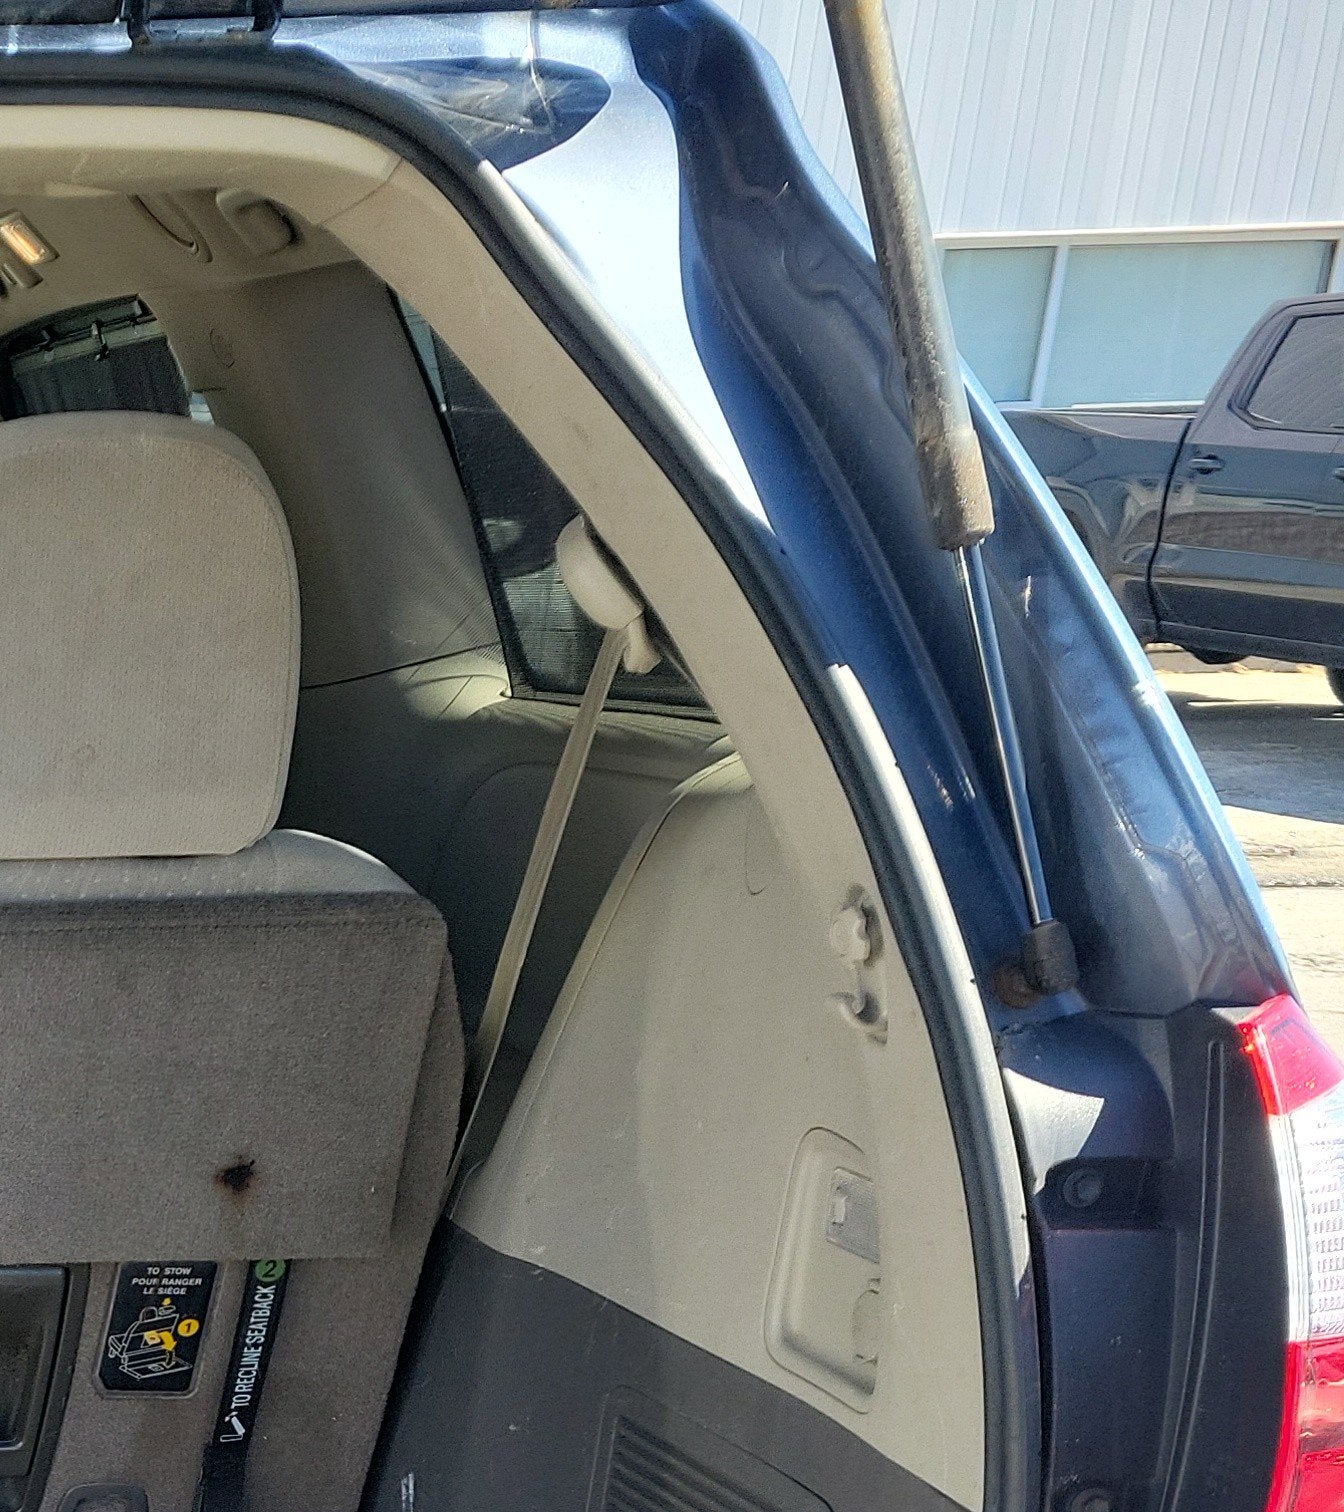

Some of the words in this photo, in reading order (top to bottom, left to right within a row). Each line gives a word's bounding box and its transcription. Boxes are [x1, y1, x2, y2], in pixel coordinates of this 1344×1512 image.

[147, 1267, 160, 1275] TO
[164, 1267, 192, 1275] STOW
[263, 1260, 277, 1278] 2
[161, 1278, 203, 1286] RANGER
[143, 1287, 154, 1295] LE
[157, 1286, 187, 1295] SIÈGE
[246, 1285, 276, 1344] SEATBACK
[235, 1346, 262, 1393] RECLINE
[231, 1394, 251, 1409] TO
